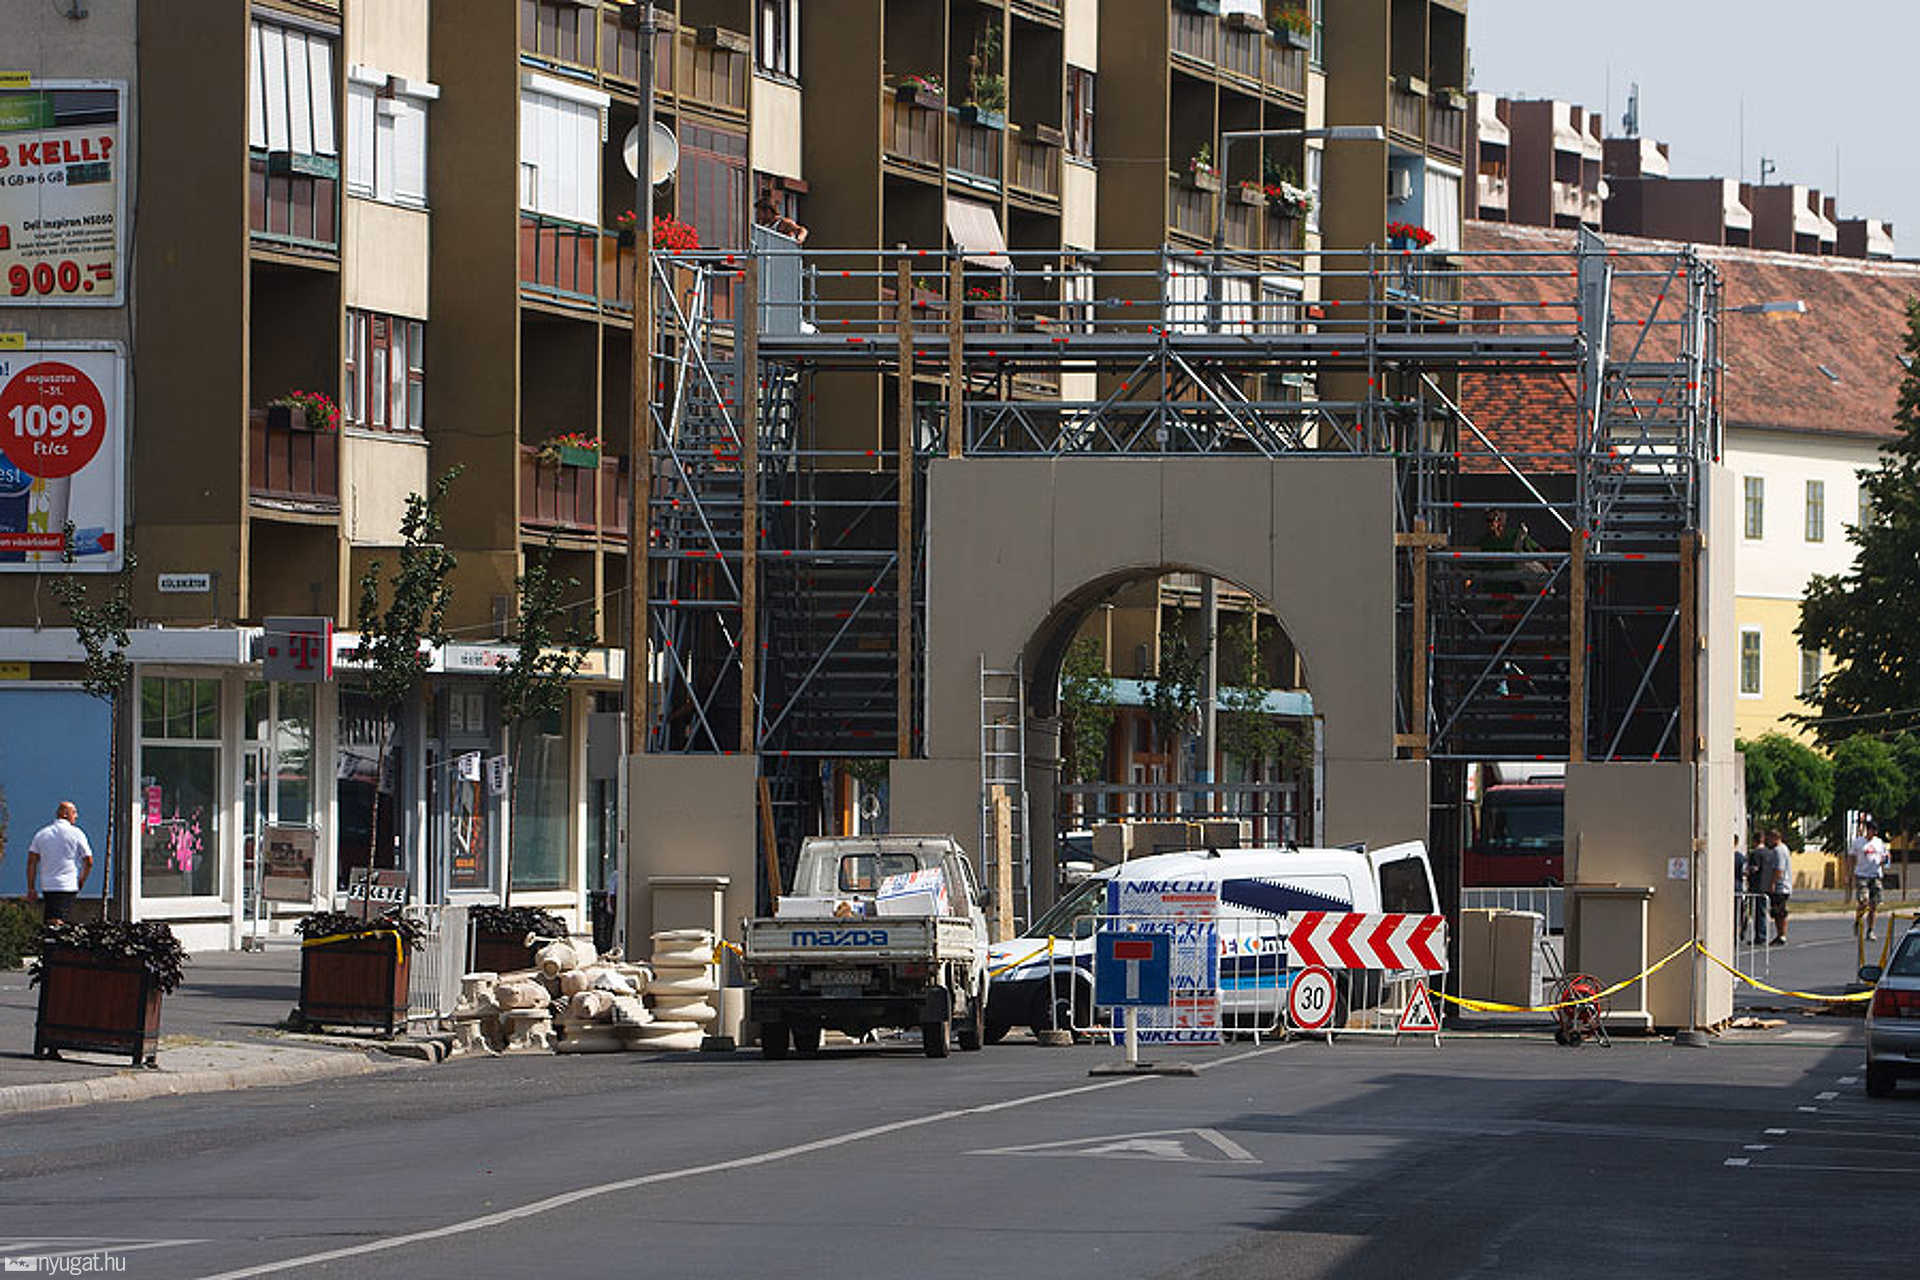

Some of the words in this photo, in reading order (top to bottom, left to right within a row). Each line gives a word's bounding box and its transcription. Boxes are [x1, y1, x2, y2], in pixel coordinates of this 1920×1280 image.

[18, 136, 114, 167] KELL?
[7, 404, 94, 437] 1099
[1124, 880, 1217, 894] NIKECELL
[1301, 986, 1325, 1010] 30
